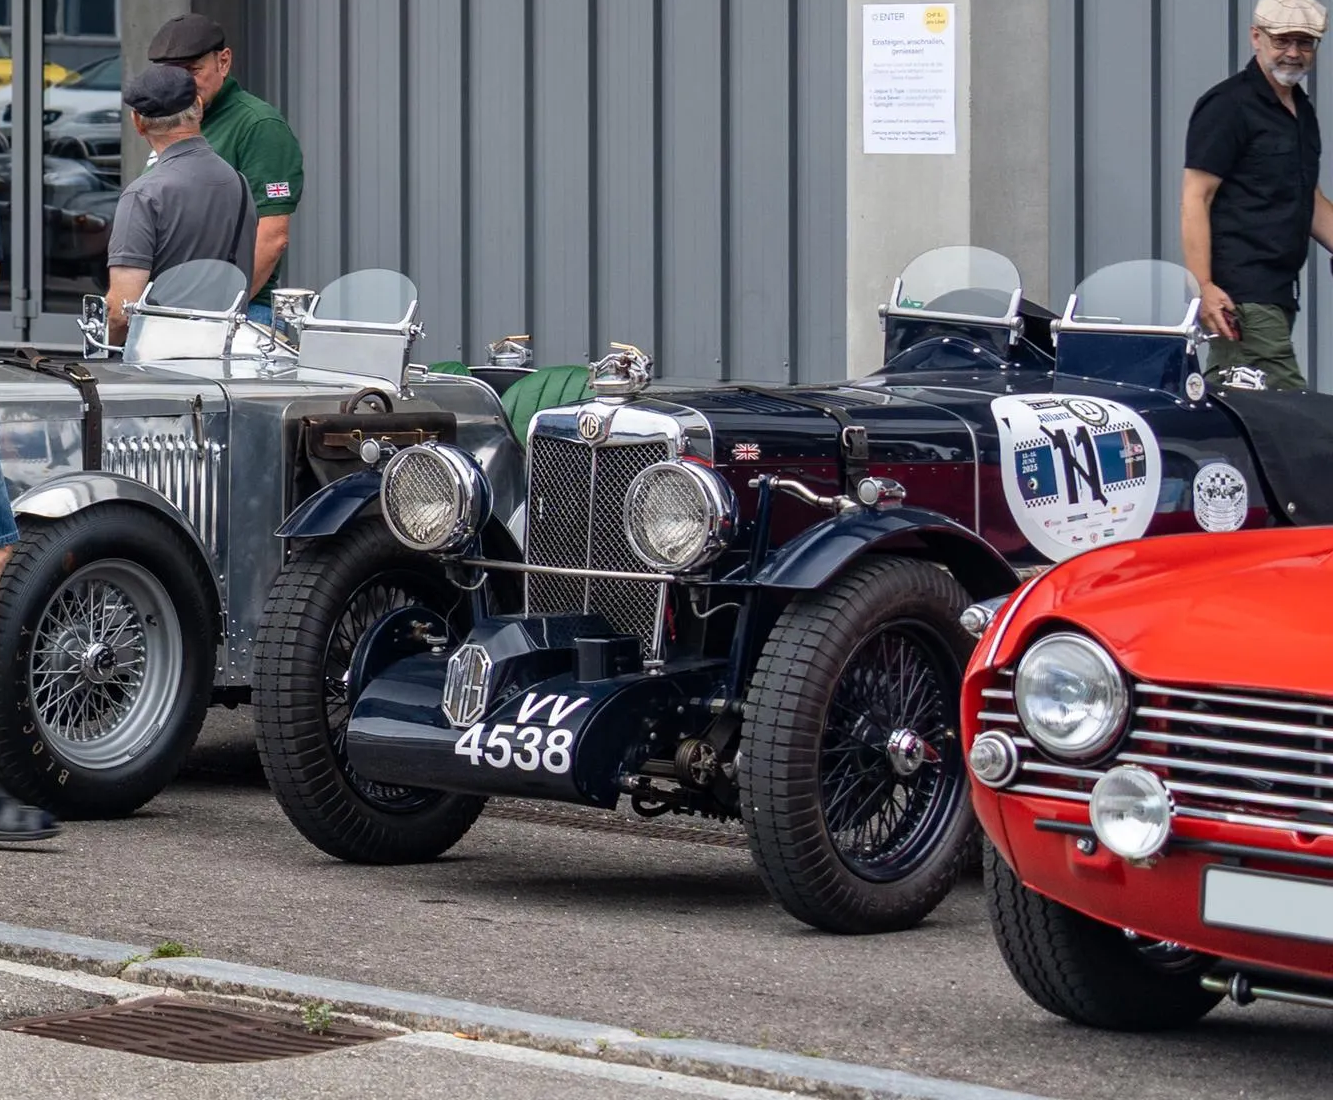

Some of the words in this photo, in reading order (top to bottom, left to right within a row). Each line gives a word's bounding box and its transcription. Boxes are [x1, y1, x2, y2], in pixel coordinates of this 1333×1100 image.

[581, 414, 598, 437] MG
[1037, 411, 1073, 424] Allianz
[443, 646, 491, 726] MG
[517, 692, 589, 726] VV
[455, 723, 573, 774] 4538
